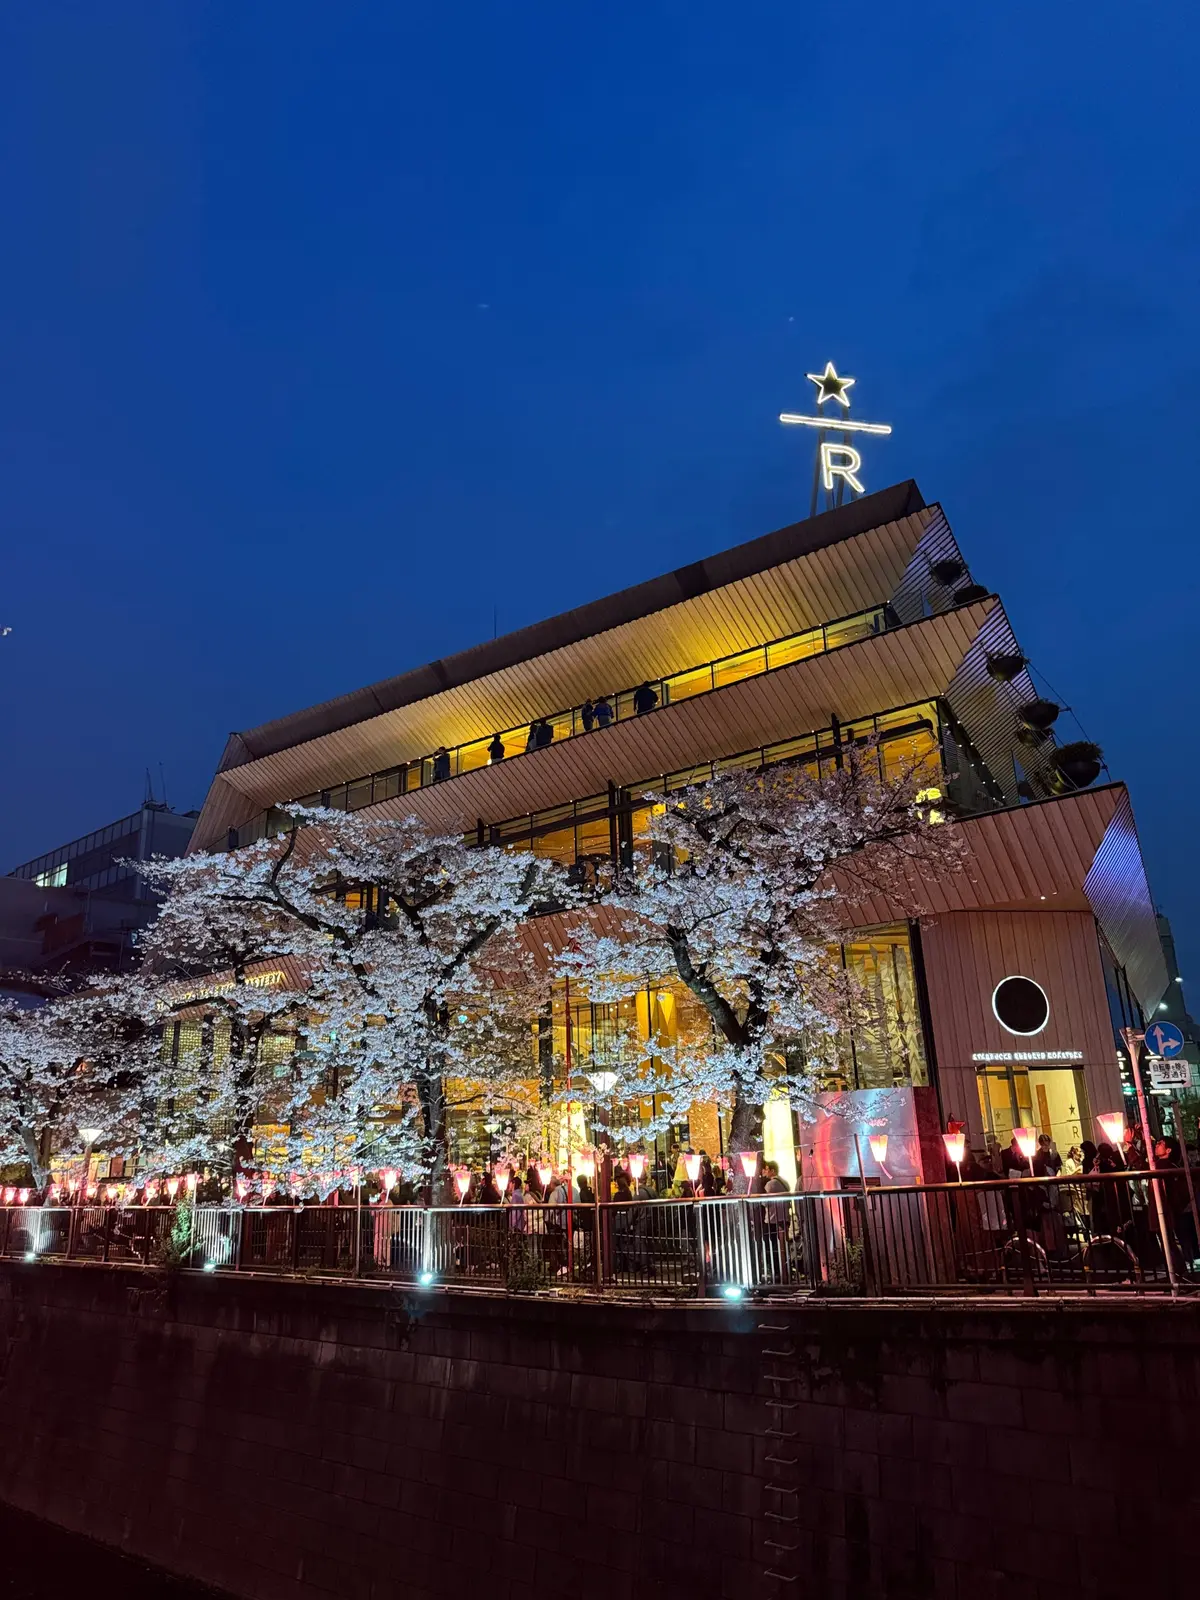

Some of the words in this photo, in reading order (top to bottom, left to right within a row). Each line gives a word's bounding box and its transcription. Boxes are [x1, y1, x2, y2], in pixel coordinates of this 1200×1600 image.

[820, 442, 866, 493] R
[1153, 1062, 1187, 1072] 自転車を除く
[1154, 1071, 1187, 1079] 一方通行
[1072, 1125, 1080, 1139] R
